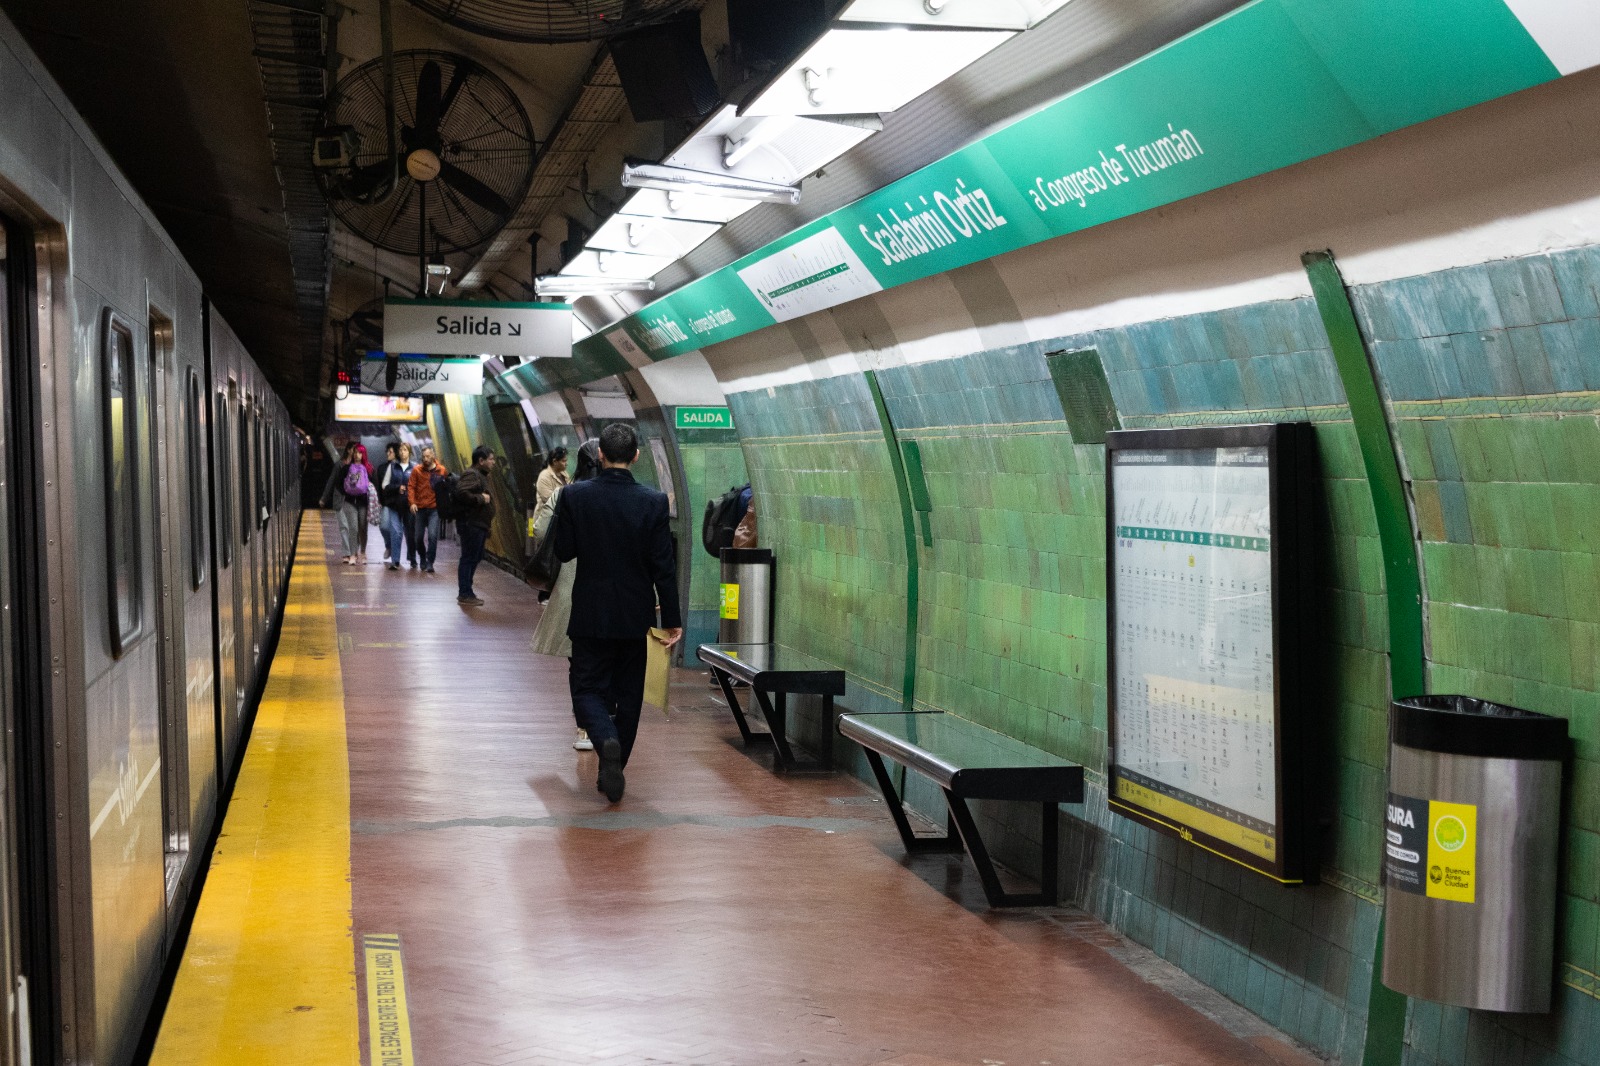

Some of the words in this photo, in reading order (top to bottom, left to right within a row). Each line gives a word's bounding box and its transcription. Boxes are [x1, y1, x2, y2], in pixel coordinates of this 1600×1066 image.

[1115, 122, 1204, 178] Tucumán
[1102, 151, 1128, 186] de
[1037, 164, 1106, 208] Congreso
[1028, 187, 1047, 212] a
[859, 195, 956, 266] Scalabrini
[933, 178, 1008, 238] Ortiz
[437, 316, 501, 336] Salida
[396, 368, 436, 381] Salida
[683, 412, 724, 424] SALIDA
[1387, 804, 1415, 829] SURA
[1445, 867, 1470, 876] Buenos
[1444, 880, 1469, 889] Ciudad
[377, 982, 396, 997] TREN
[377, 1004, 398, 1020] ENTRE
[379, 1022, 401, 1048] ESPACIO
